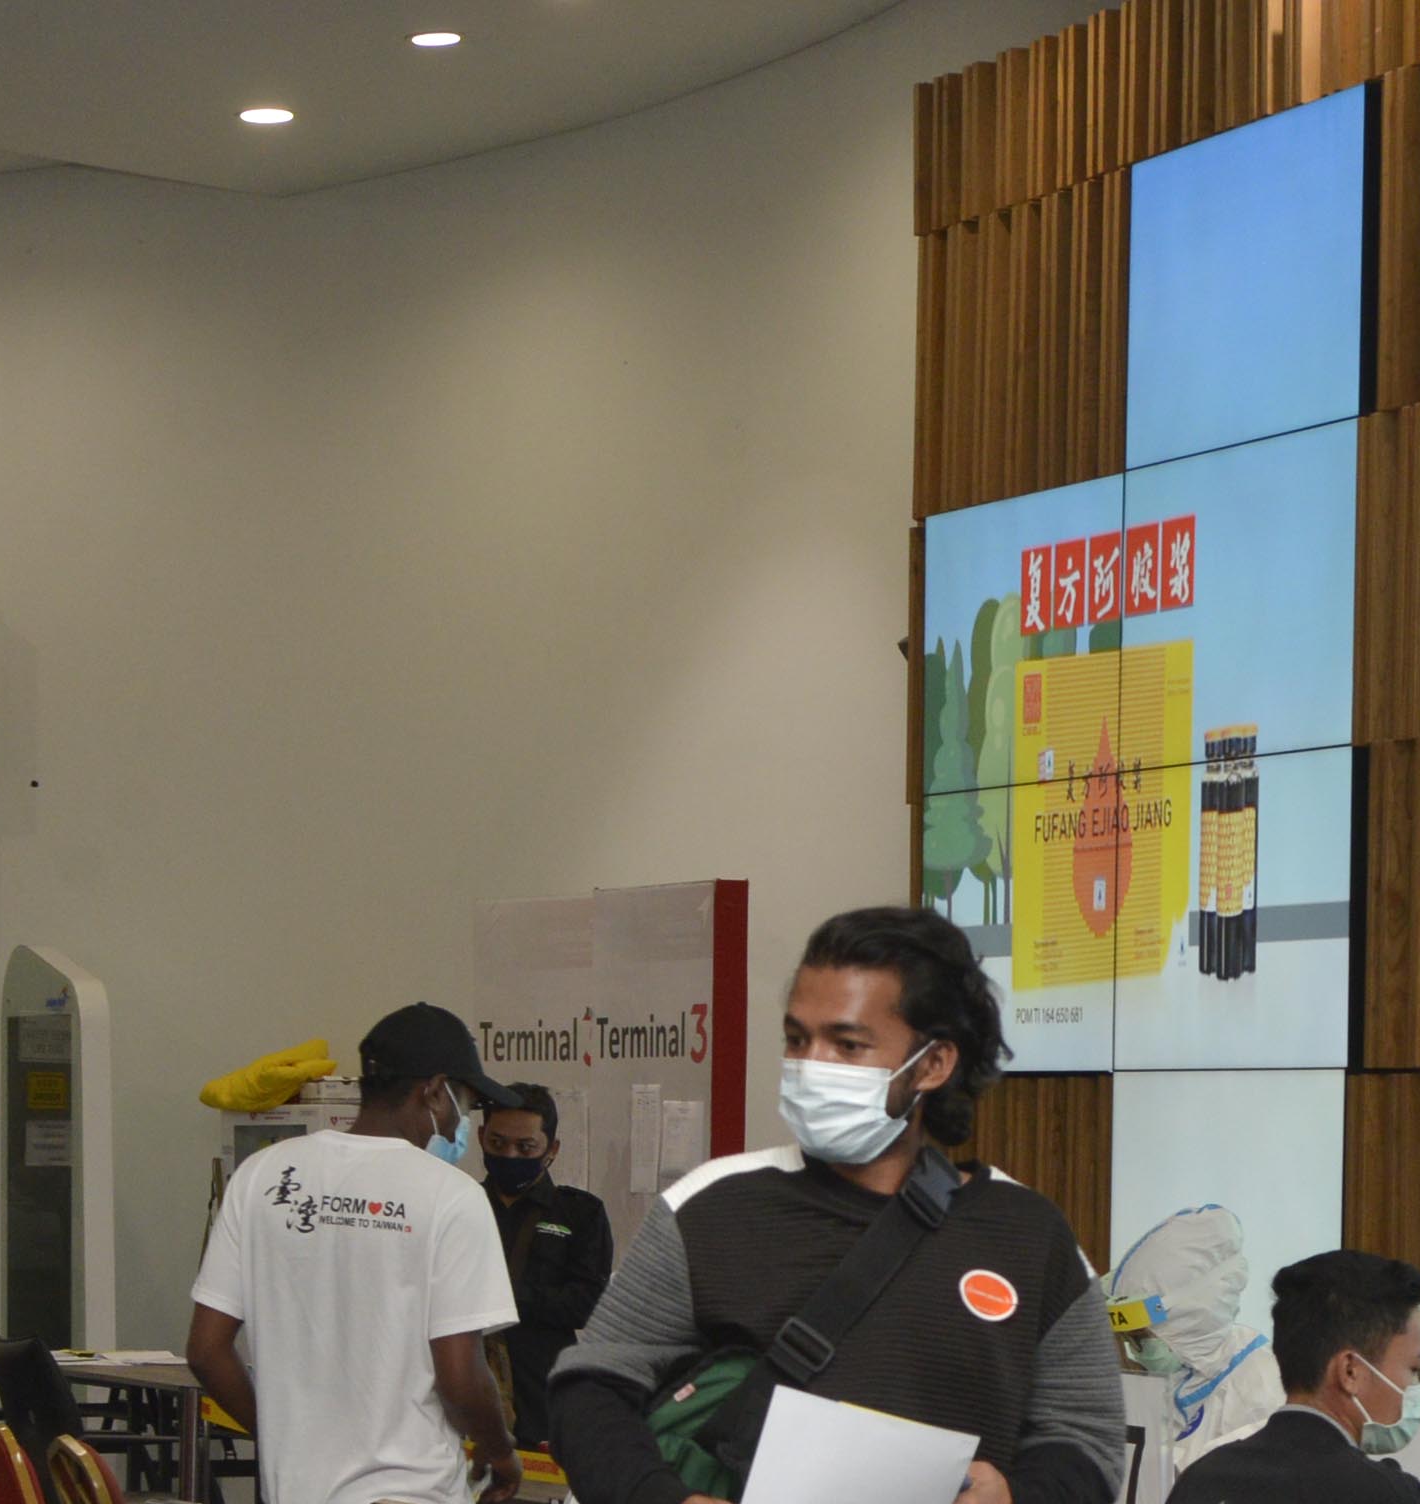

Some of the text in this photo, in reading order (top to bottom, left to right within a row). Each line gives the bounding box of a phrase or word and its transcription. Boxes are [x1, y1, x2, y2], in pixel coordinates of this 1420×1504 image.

[1034, 798, 1173, 844] FUFANG EJIAO JIANG
[479, 1016, 578, 1063] Terminal
[596, 1011, 686, 1060] Terminal
[689, 1003, 709, 1065] 3
[318, 1215, 403, 1232] WELCOME TO TAIWAN
